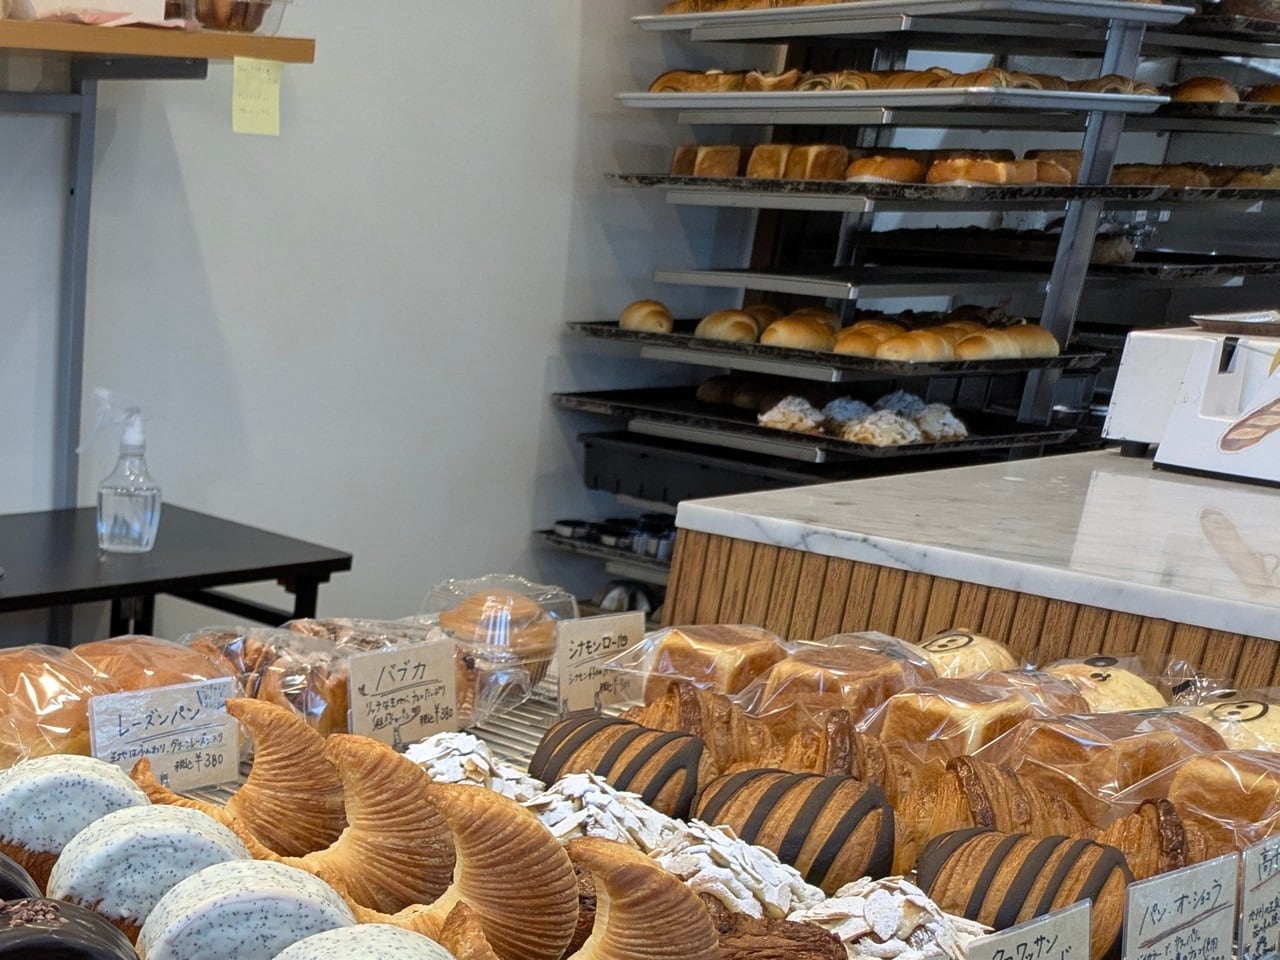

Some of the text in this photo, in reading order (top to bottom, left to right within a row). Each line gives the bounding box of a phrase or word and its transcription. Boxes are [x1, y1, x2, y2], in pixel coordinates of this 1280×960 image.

[569, 635, 628, 660] シナモンロール
[376, 660, 426, 691] バブカ
[119, 705, 200, 737] レーズンパン
[174, 753, 224, 772] 税込 ¥380
